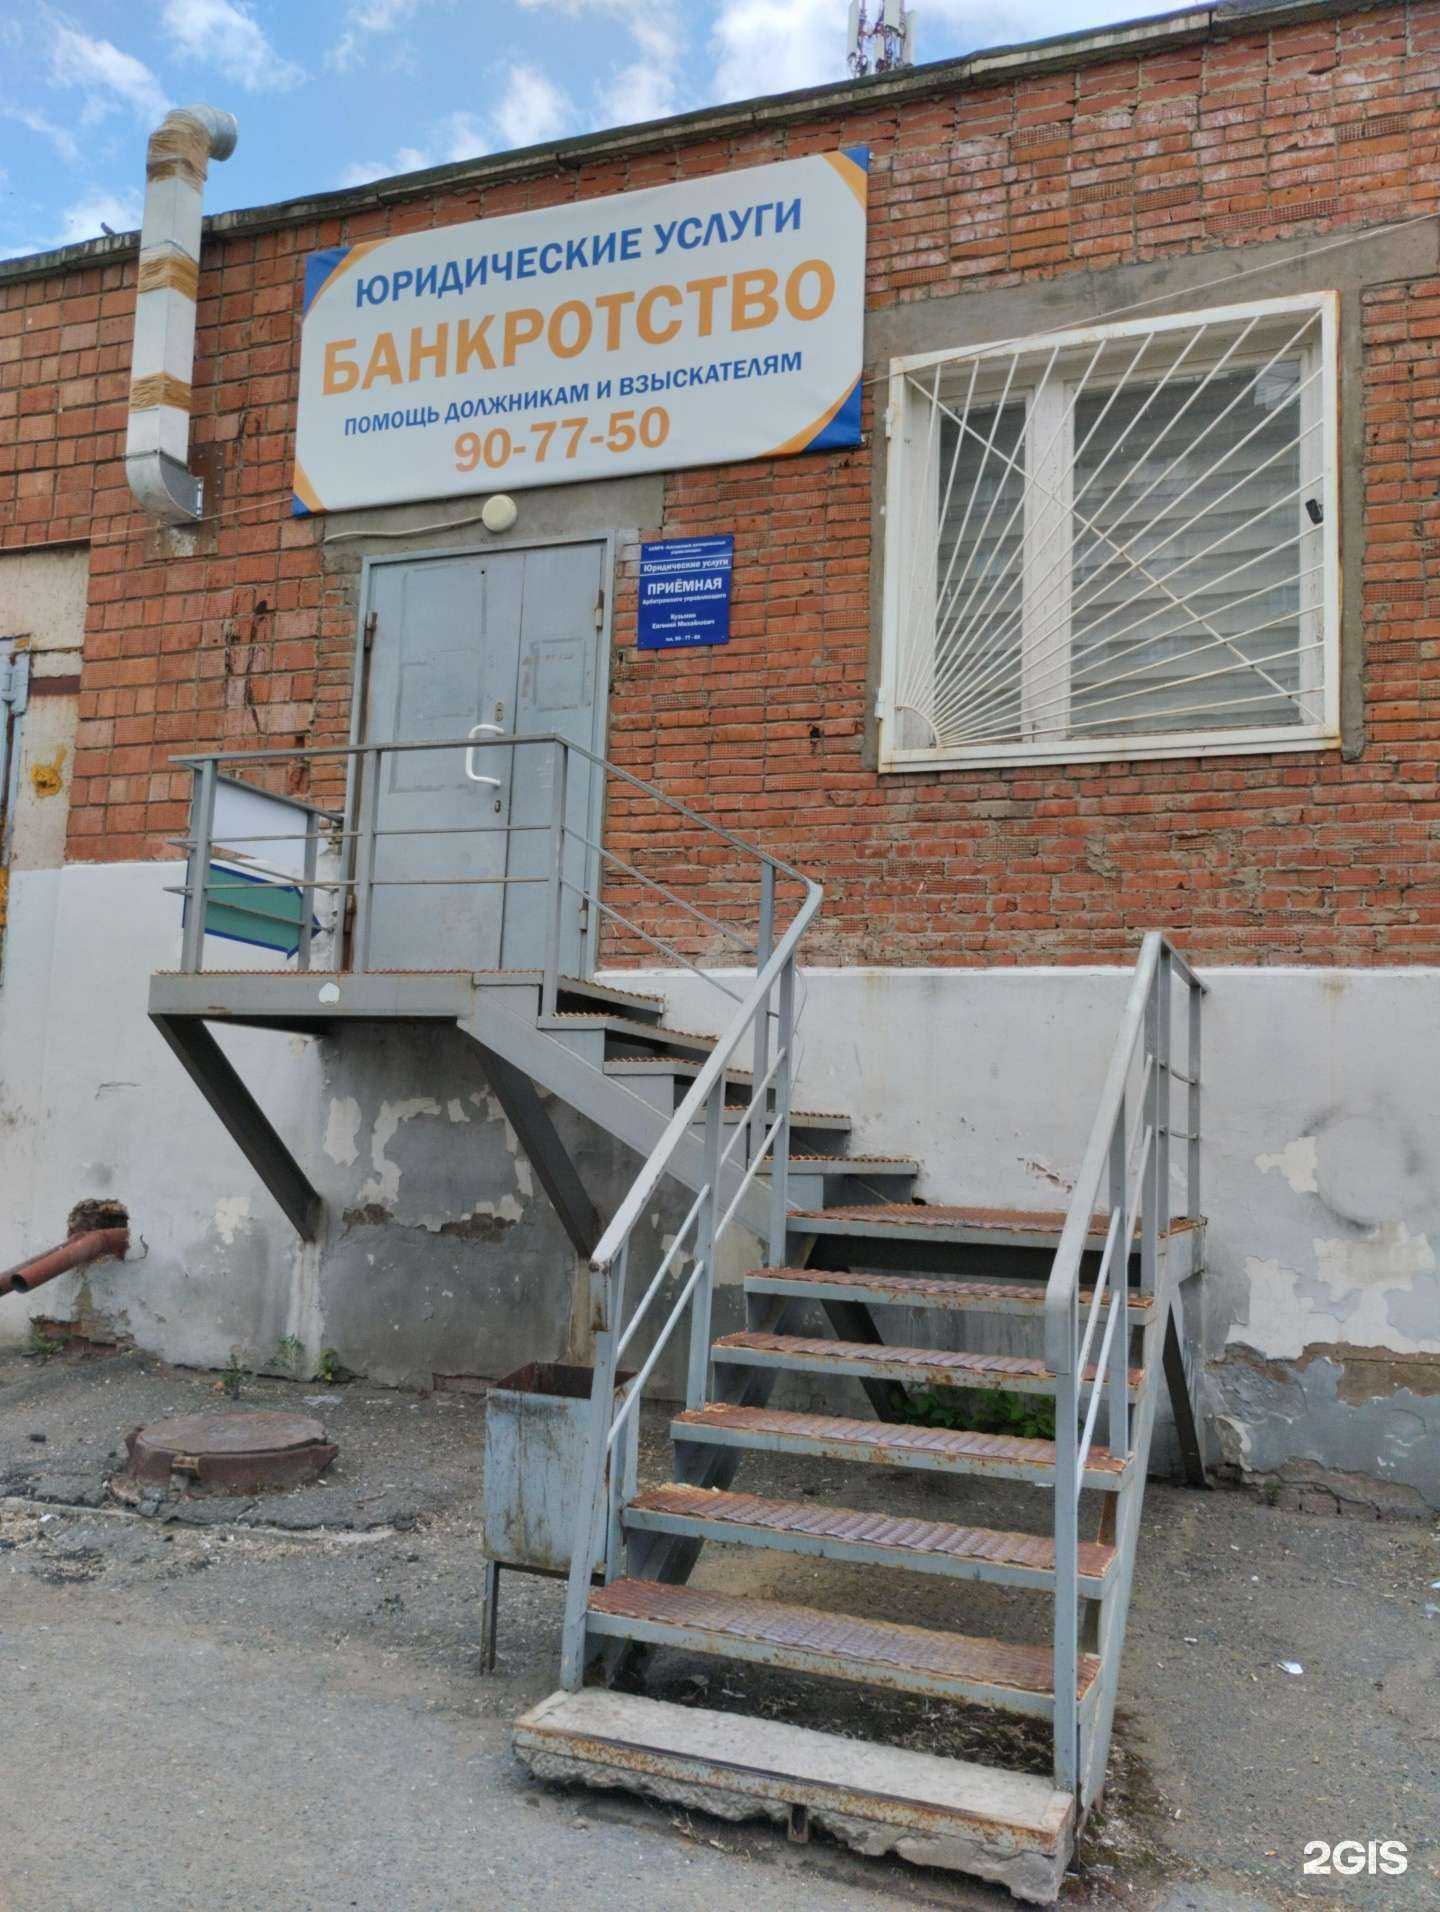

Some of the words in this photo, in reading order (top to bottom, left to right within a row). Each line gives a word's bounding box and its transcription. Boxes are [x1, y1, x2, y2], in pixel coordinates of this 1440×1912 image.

[356, 228, 642, 307] ЮРИДИЧЕСКИЕ
[653, 198, 802, 254] УСЛУГИ
[322, 259, 835, 395] БАНКРОТСТВО
[344, 406, 439, 436] ПОМОЩЬ
[445, 383, 589, 424] ДОЛЖНИКАМ
[597, 381, 611, 399] И
[619, 351, 802, 396] ВЗЫСКАТЕЛЯМ
[454, 406, 670, 472] 90-77-50
[643, 561, 701, 573] Юридические
[702, 559, 729, 569] услуги
[647, 577, 723, 595] ПРИЁМНАЯ
